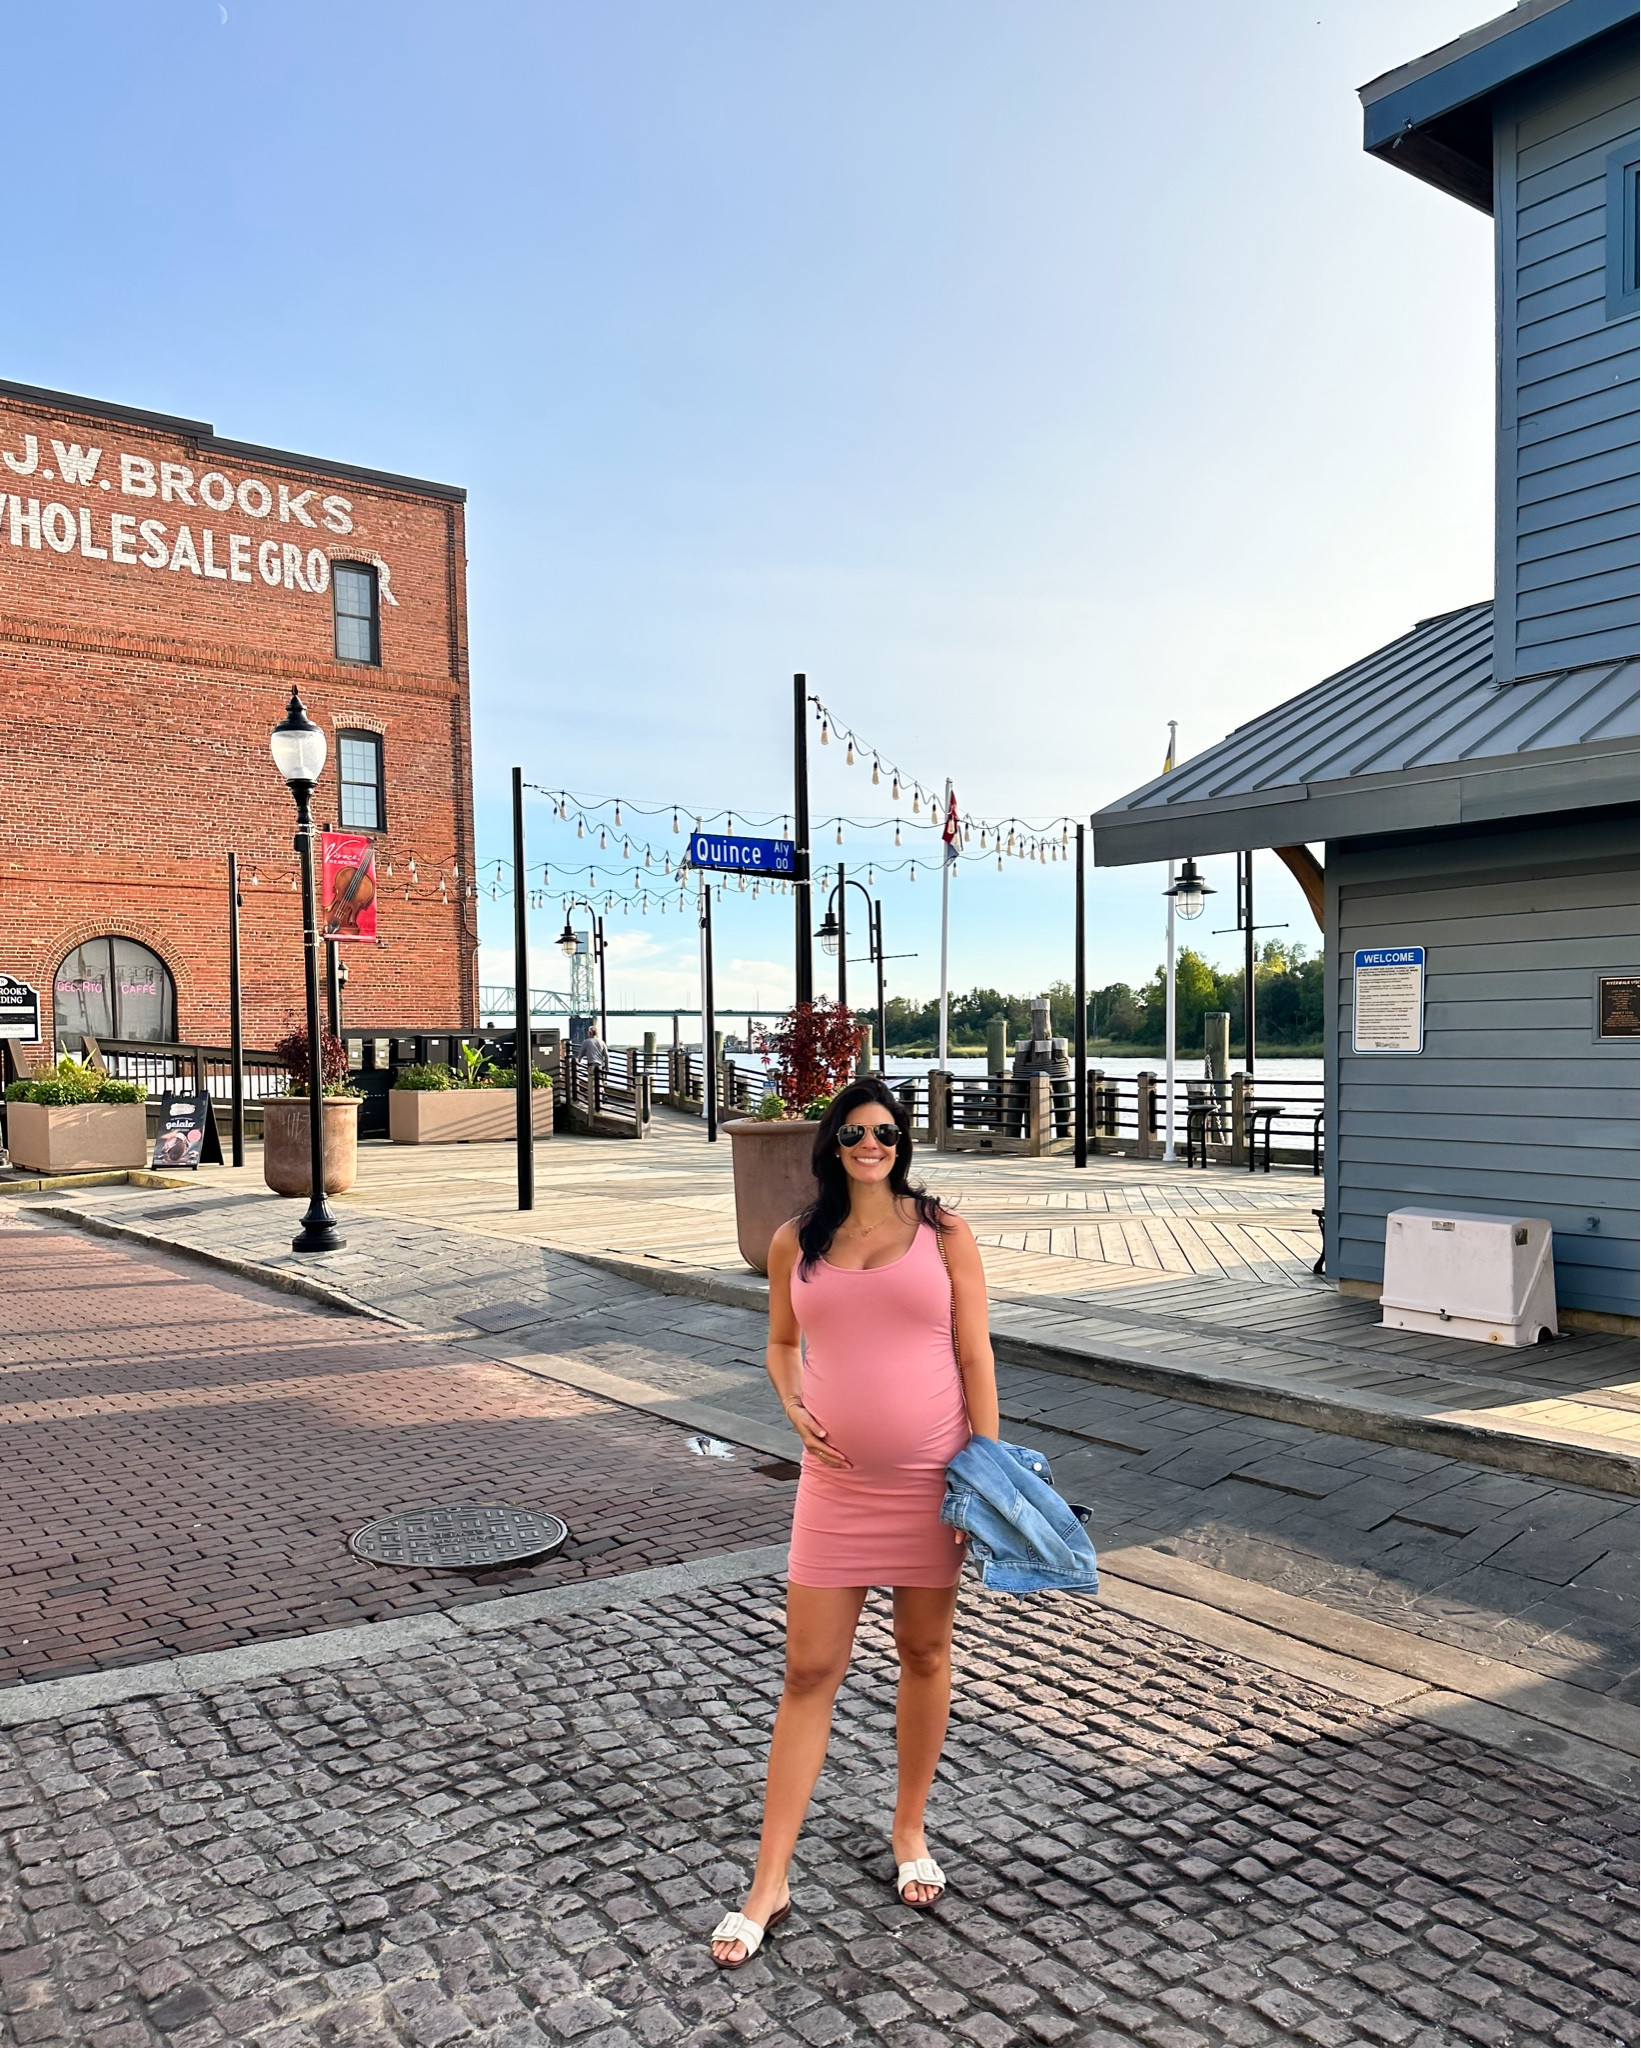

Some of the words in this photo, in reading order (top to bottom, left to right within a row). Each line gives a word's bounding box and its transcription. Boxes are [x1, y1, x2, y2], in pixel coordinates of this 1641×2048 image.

[2, 434, 111, 491] J.W.
[120, 453, 354, 534] BROOKS
[697, 838, 761, 864] Quince
[774, 842, 789, 856] Aly
[776, 858, 788, 868] 00
[1364, 952, 1414, 963] WELCOME
